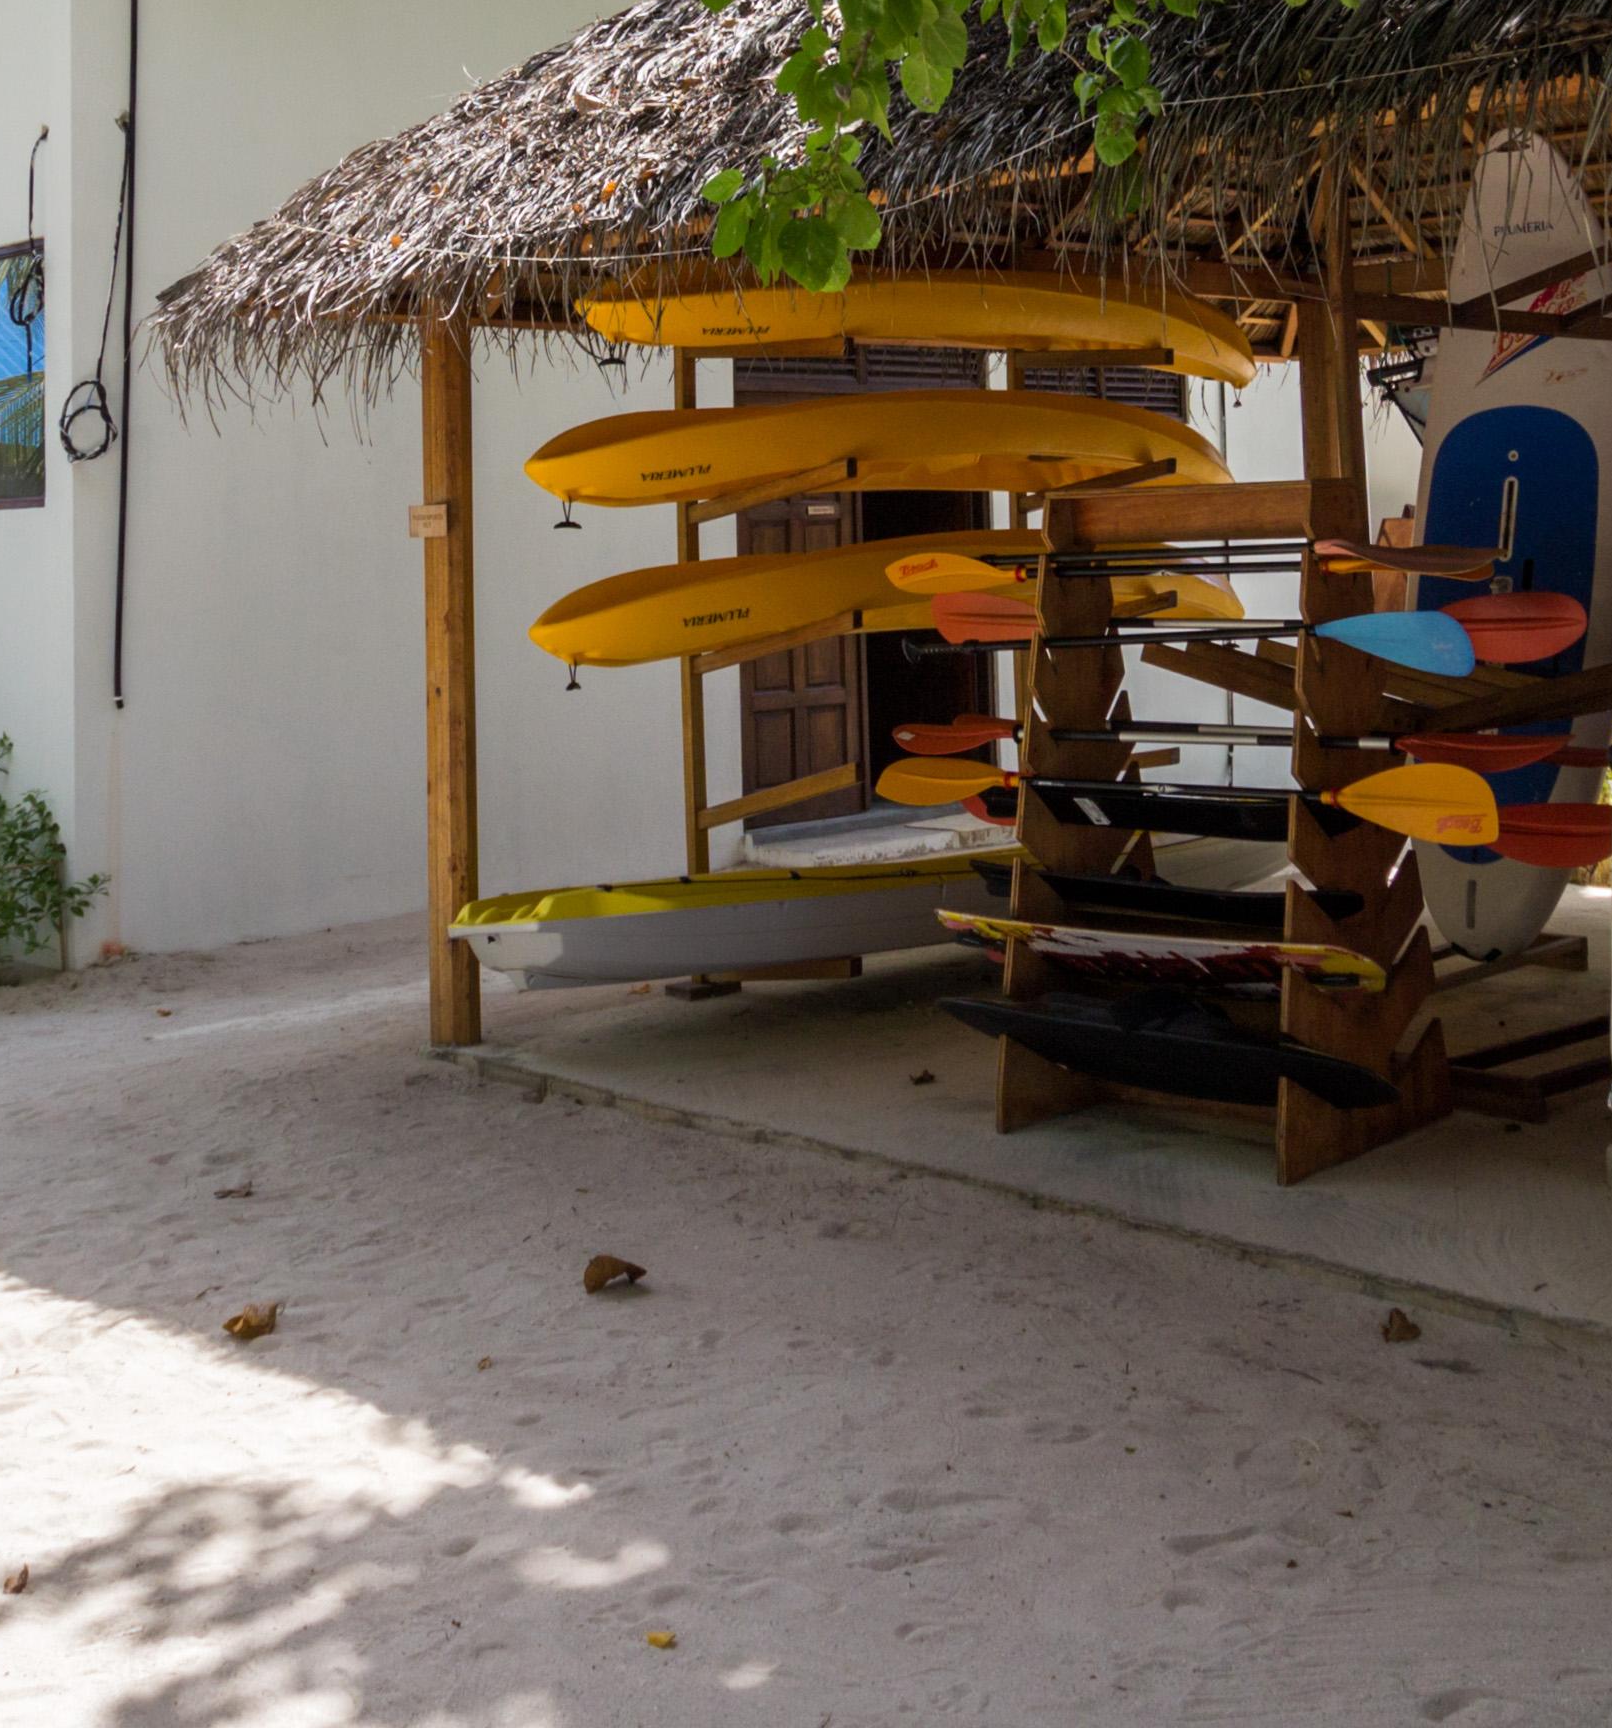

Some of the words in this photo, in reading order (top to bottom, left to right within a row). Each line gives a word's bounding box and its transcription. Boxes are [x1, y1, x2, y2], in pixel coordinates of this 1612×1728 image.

[1493, 221, 1554, 236] PLUMERIA
[641, 464, 711, 481] PLUMERIA
[683, 608, 750, 627] PLUMERIA
